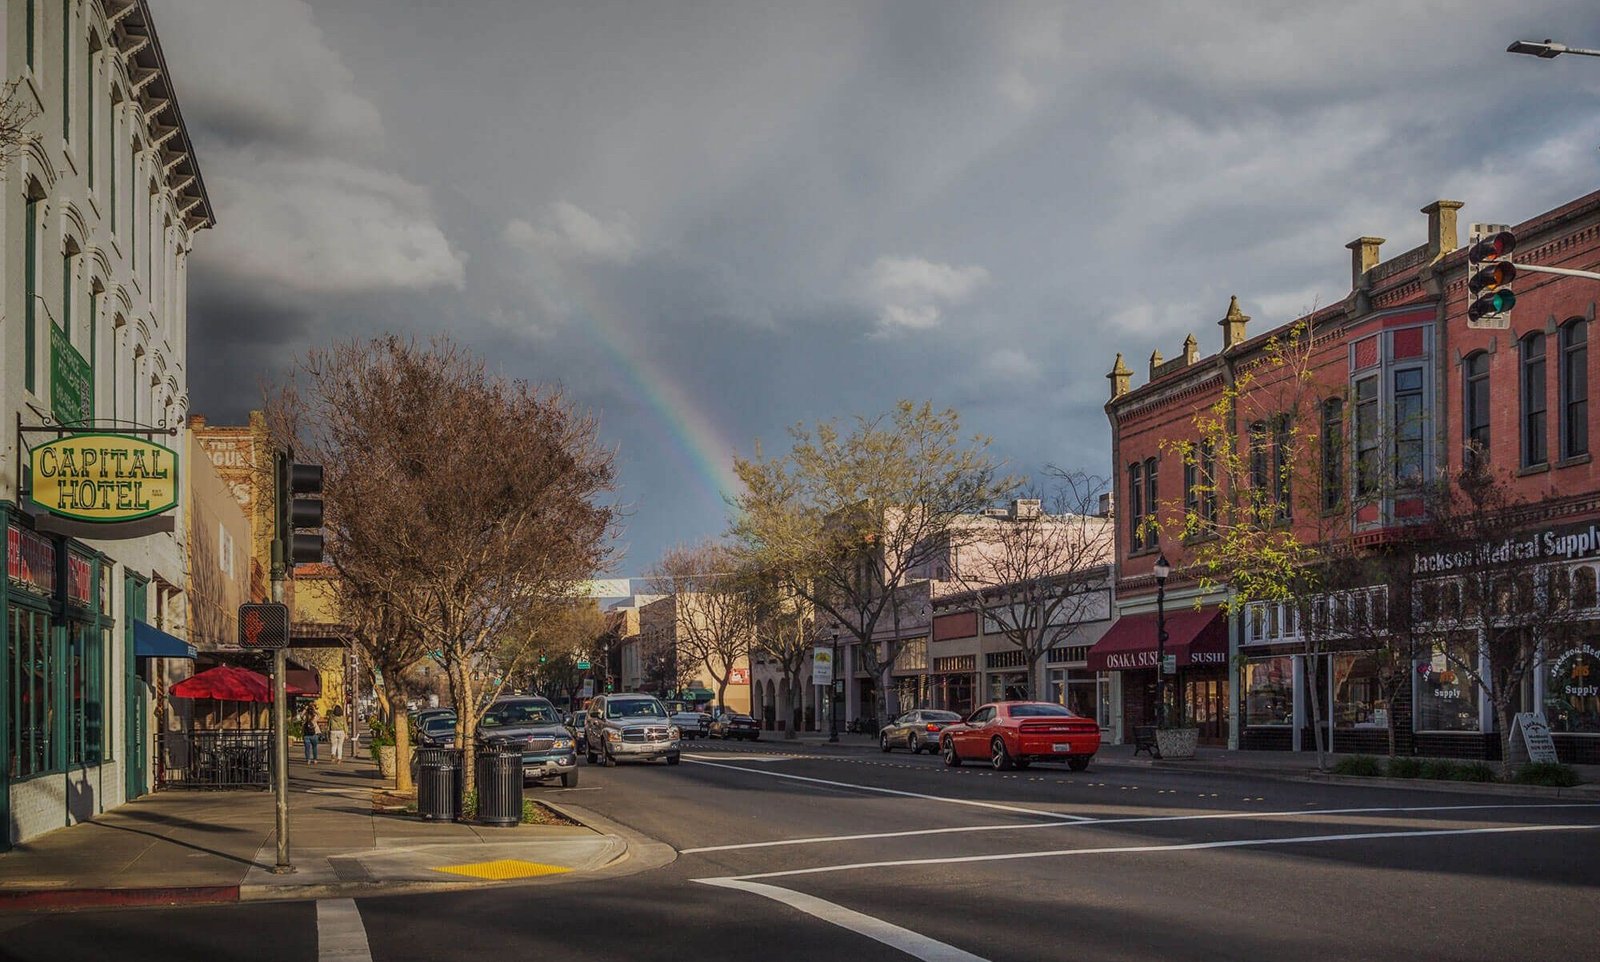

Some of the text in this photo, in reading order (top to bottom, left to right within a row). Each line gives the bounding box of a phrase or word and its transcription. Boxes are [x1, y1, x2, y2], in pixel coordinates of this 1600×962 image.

[40, 447, 168, 479] CAPITAL
[57, 479, 150, 511] HOTEL
[1413, 550, 1472, 574] Jackson
[1476, 533, 1539, 565] Medical
[1106, 653, 1136, 668] OSAKA
[1138, 651, 1158, 666] SUS
[1191, 653, 1225, 664] SUSHI
[1434, 688, 1461, 698] Supply
[1565, 685, 1599, 696] Supply
